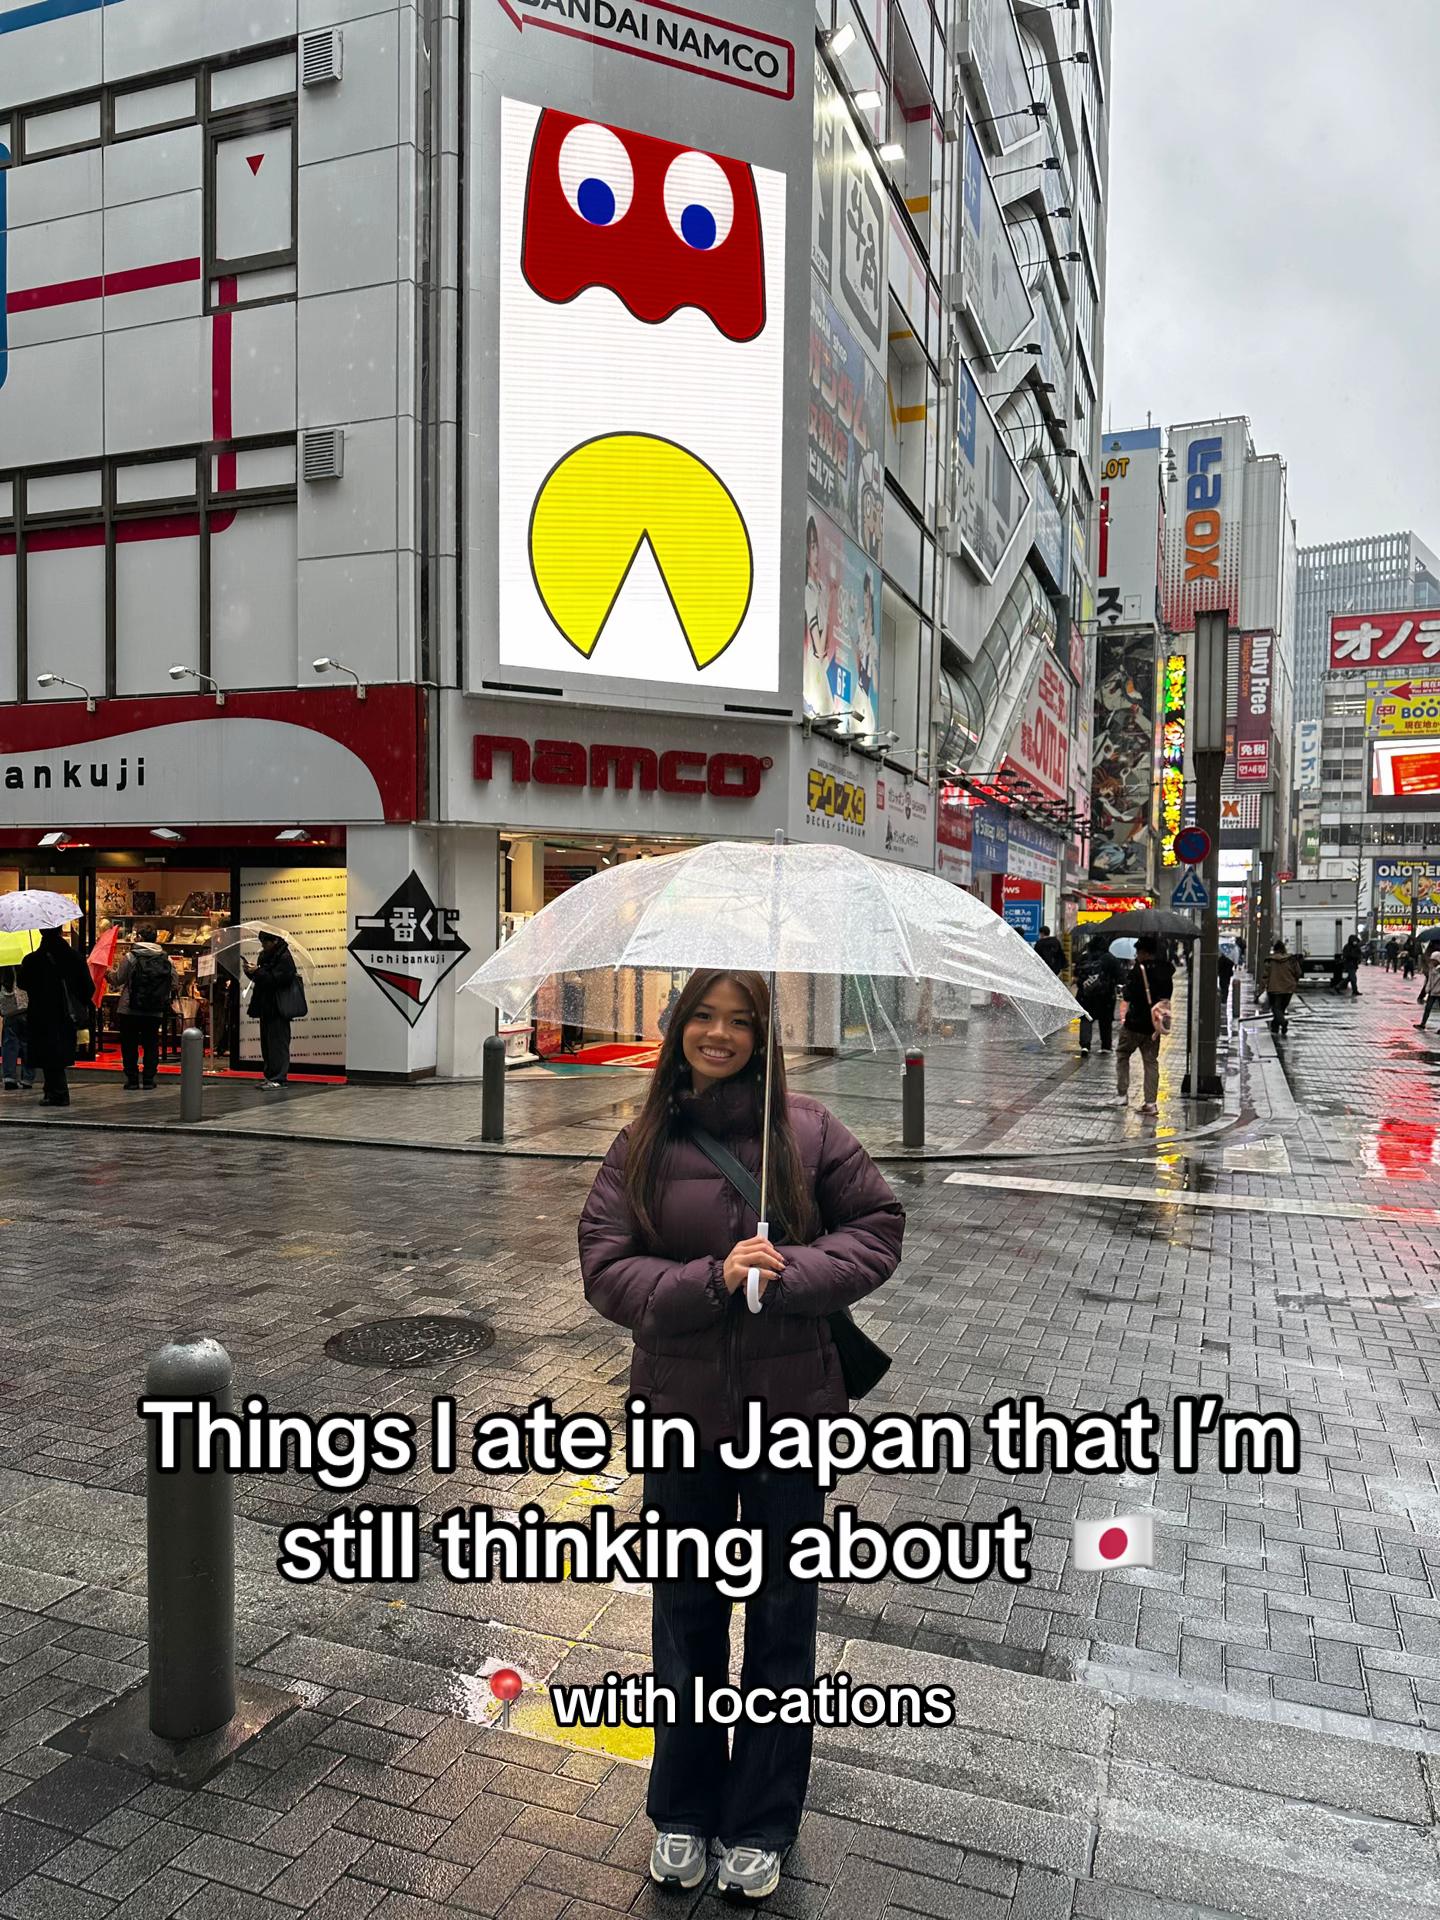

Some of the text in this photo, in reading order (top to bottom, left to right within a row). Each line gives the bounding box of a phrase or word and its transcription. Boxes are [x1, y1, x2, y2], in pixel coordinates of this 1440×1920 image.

[656, 17, 779, 79] NAMCO
[1241, 674, 1249, 697] Store
[1250, 636, 1272, 715] Duty Free
[1034, 705, 1067, 790] OUTLET
[1240, 743, 1266, 757] 免税
[5, 757, 145, 791] ankuji
[355, 905, 459, 943] 一番くじ
[370, 953, 446, 966] ichibankuji
